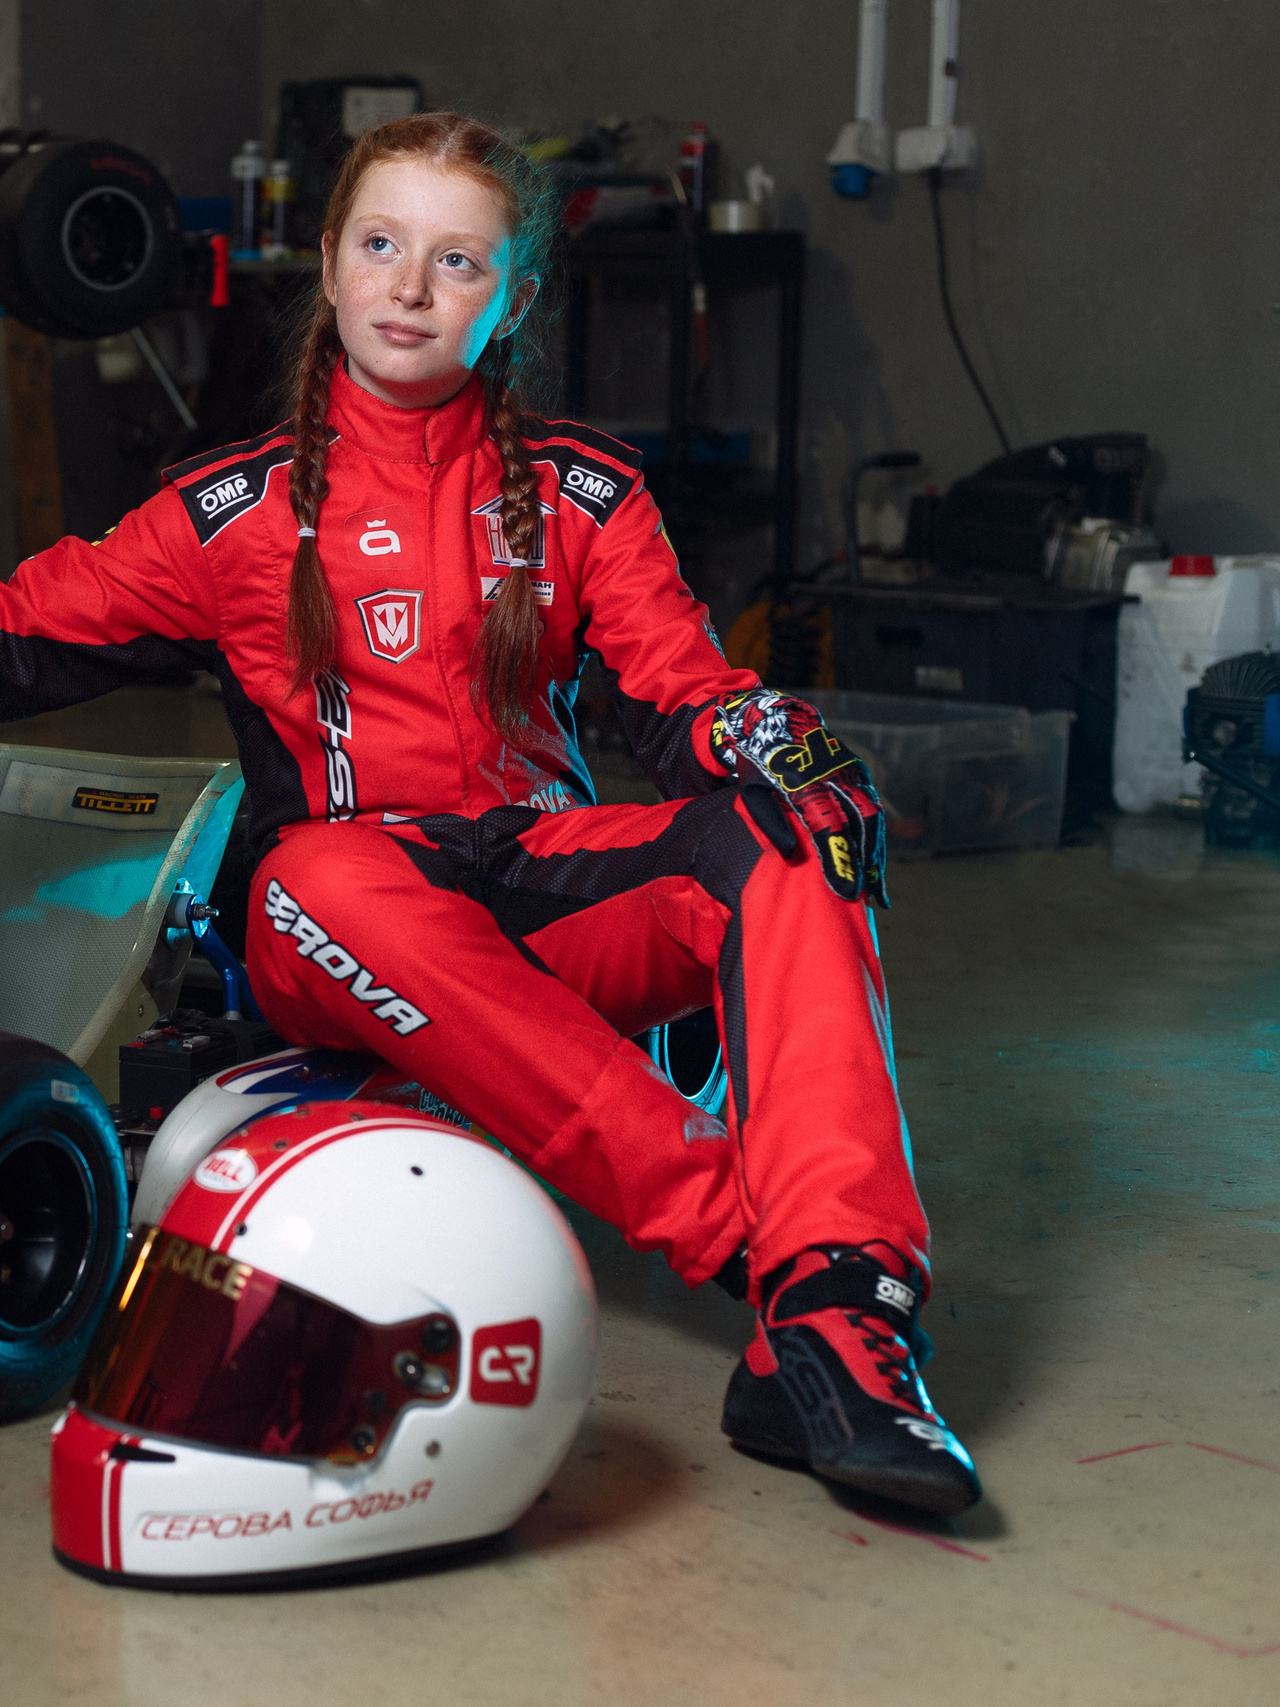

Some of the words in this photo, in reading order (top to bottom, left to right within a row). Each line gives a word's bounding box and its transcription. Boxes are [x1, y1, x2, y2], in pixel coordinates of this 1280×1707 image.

[201, 477, 248, 512] OMP
[565, 469, 615, 500] OMP
[76, 793, 157, 813] TILLETT
[160, 1237, 254, 1300] RACE
[141, 1509, 293, 1542] СЕРОВА
[304, 1478, 434, 1529] СОФЬЯ
